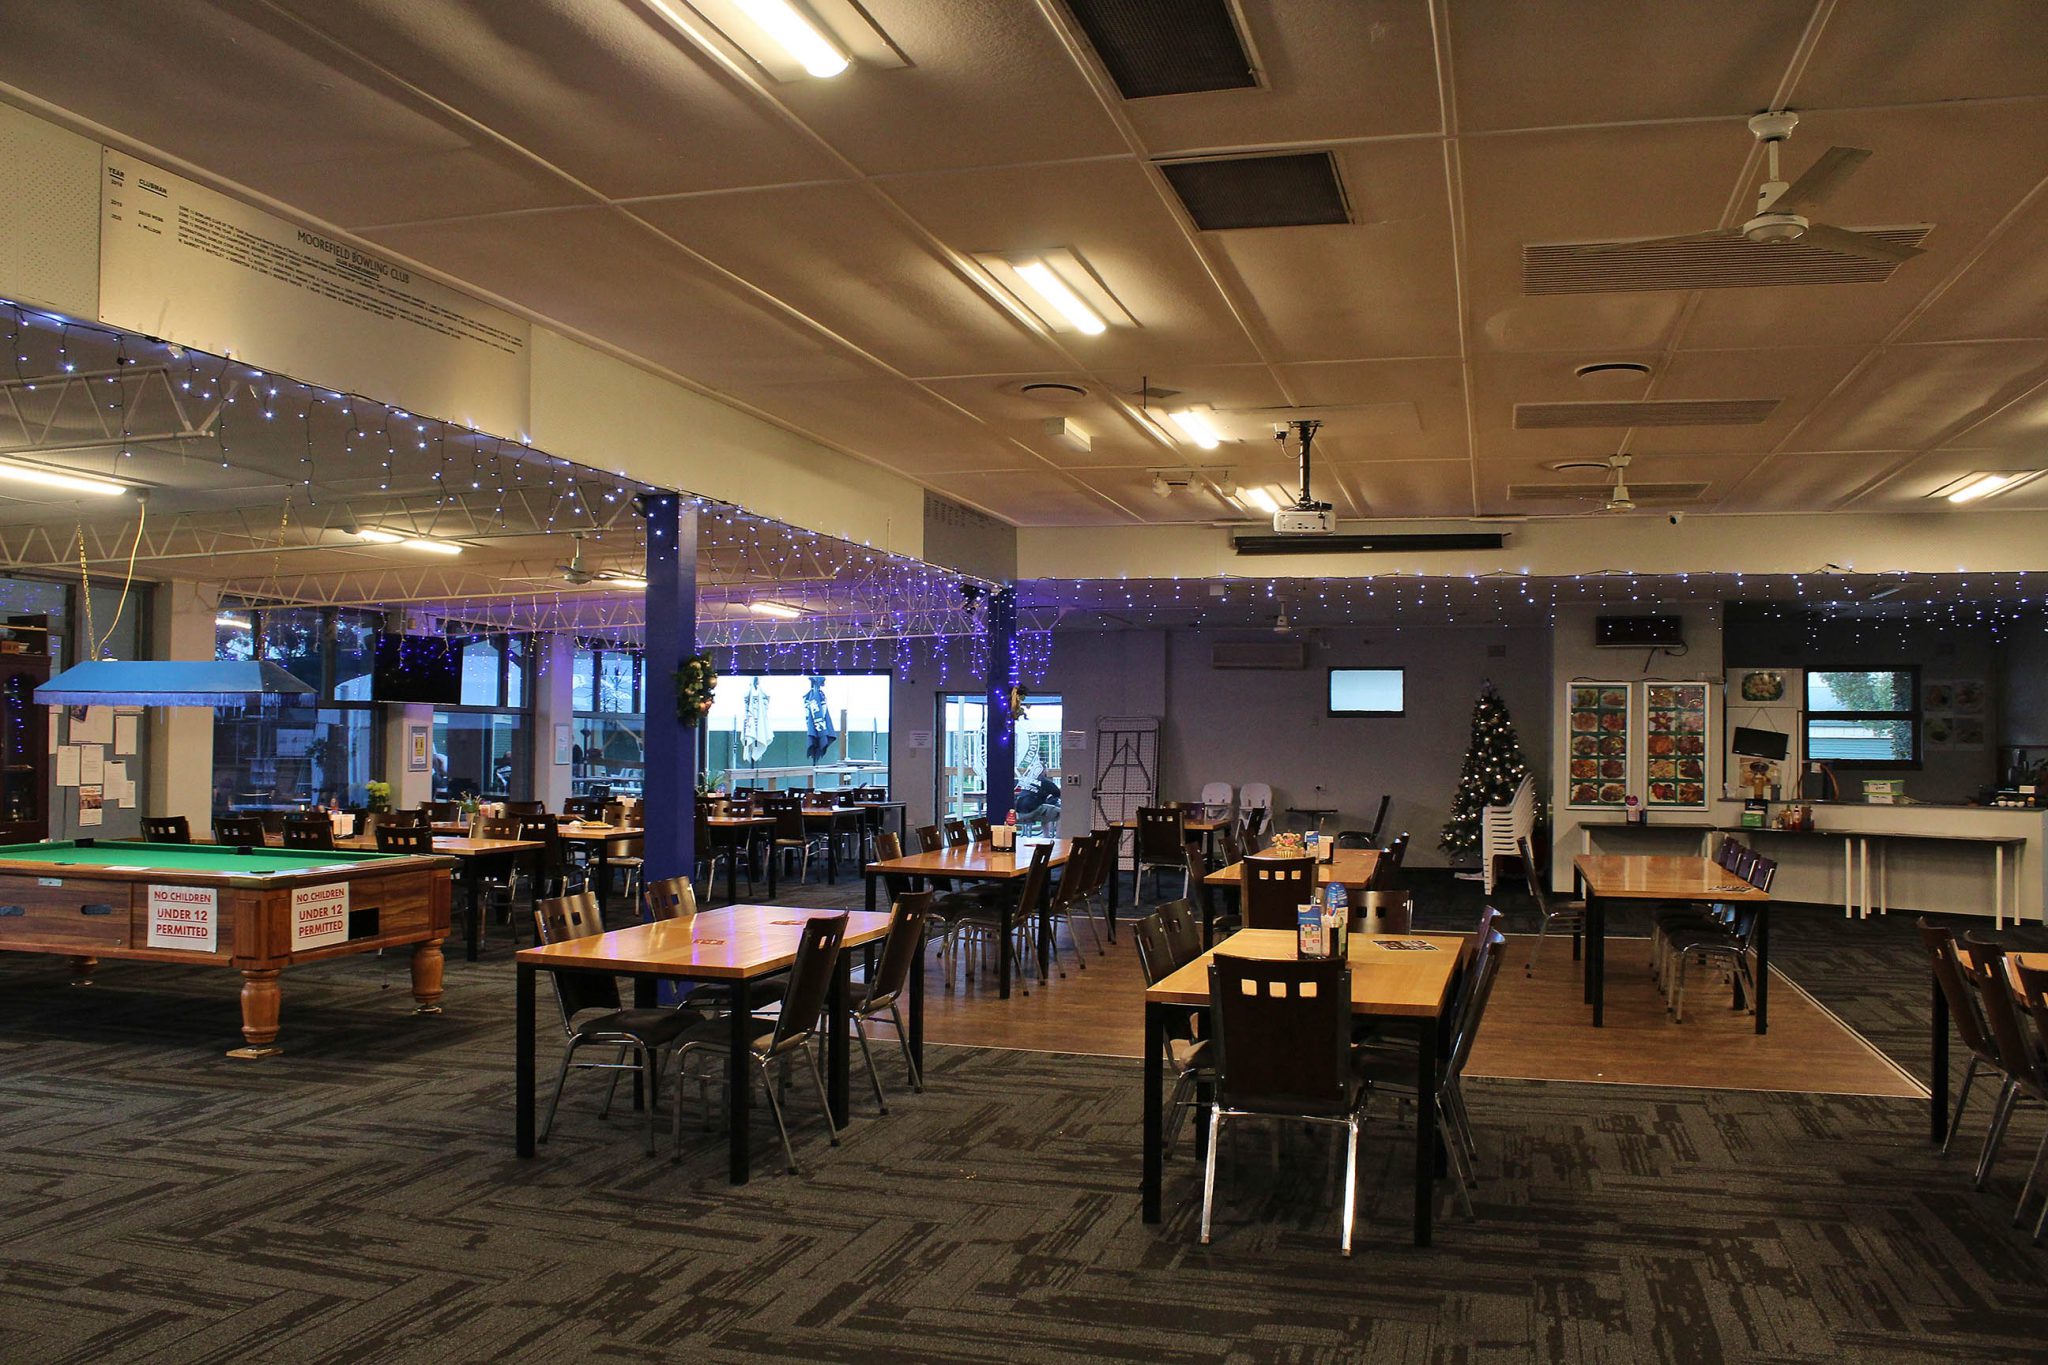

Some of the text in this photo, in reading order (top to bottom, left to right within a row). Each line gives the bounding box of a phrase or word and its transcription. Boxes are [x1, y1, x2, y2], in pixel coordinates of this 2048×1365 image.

[108, 167, 124, 177] YEAR
[139, 179, 167, 194] CLUBMAN
[297, 230, 350, 260] MOOREFIELD
[352, 251, 389, 277] BOWLING
[390, 267, 410, 284] CLUB
[154, 890, 211, 904] NO CHILDREN
[296, 887, 345, 903] NO CHILDREN
[157, 908, 208, 921] UNDER 12
[299, 904, 343, 921] UNDER 12
[156, 924, 208, 938] PERMITTED
[298, 920, 344, 937] PERMITTED
